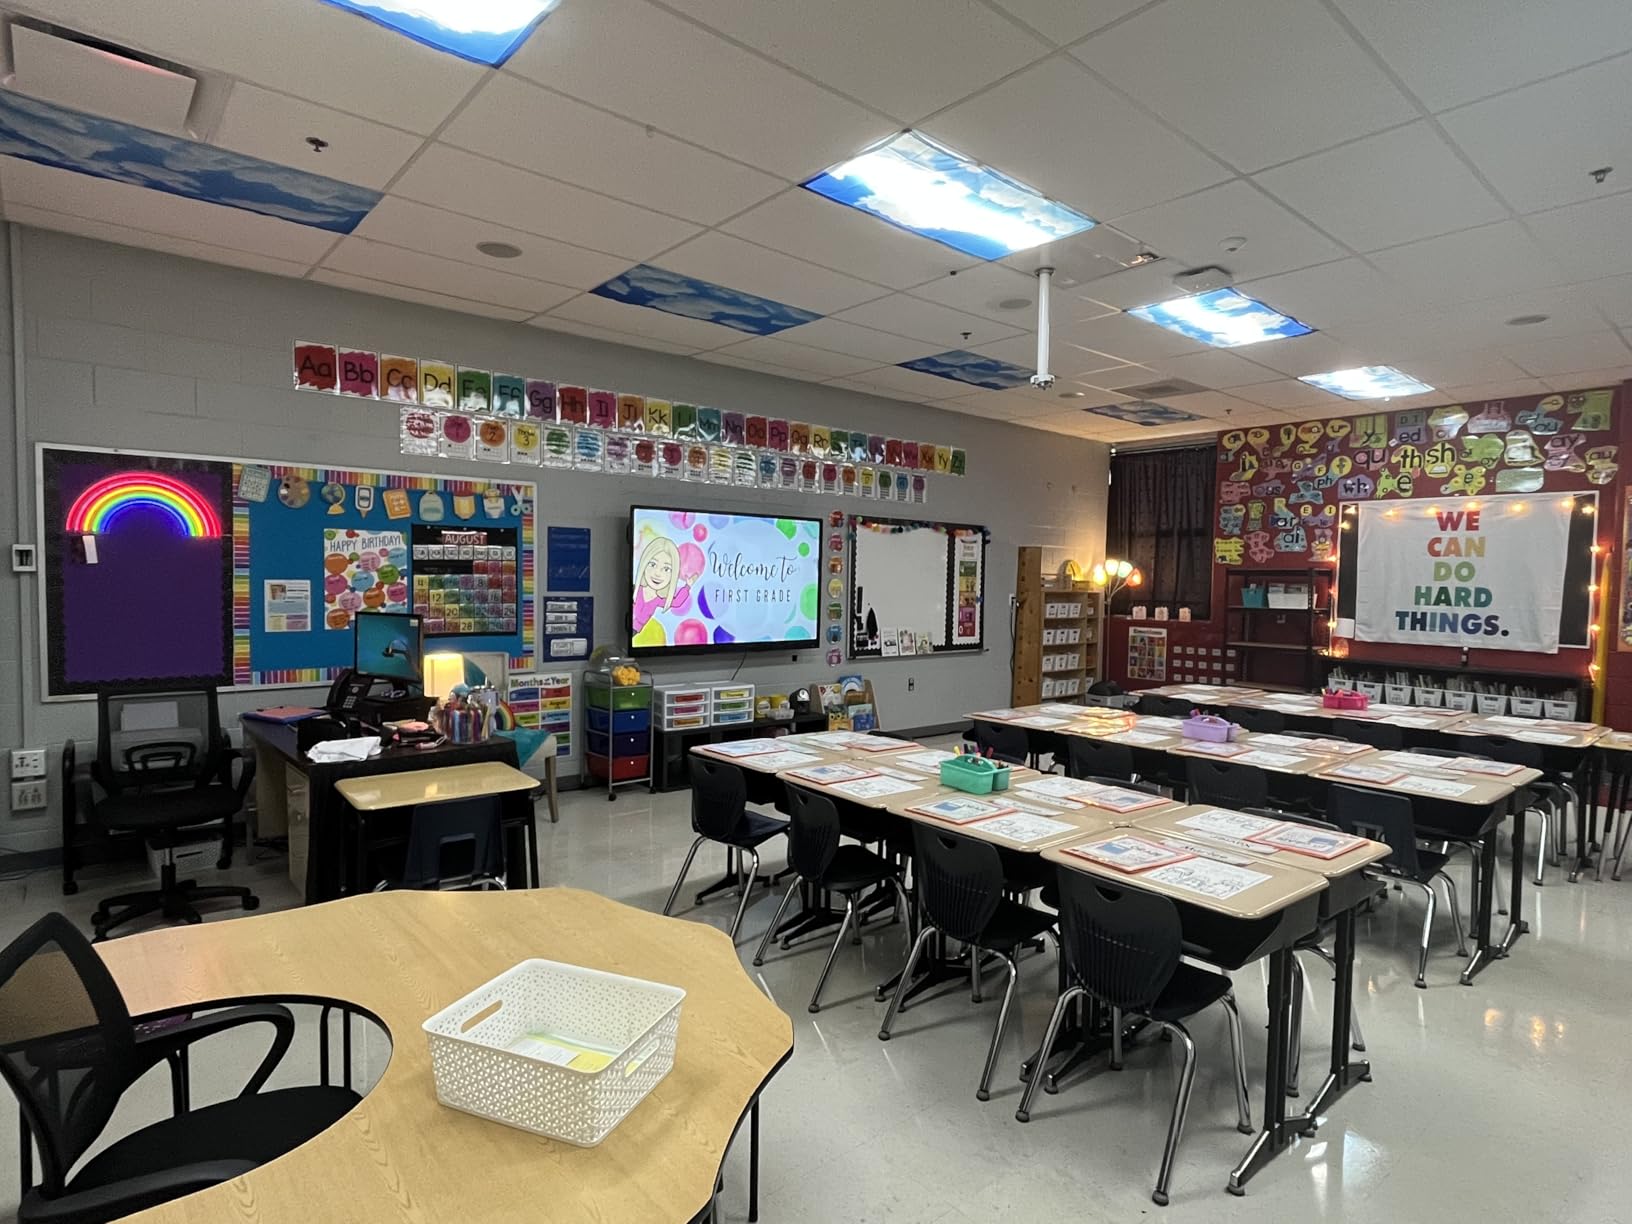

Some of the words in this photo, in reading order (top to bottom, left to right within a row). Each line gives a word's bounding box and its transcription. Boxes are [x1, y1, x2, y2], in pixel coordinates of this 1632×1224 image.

[300, 355, 334, 377] Aa
[344, 361, 375, 384] Bb
[424, 373, 453, 393] Dd
[529, 390, 553, 414] Gg
[489, 431, 498, 443] 2
[523, 435, 530, 447] 3
[1399, 428, 1421, 442] ed
[1354, 447, 1386, 470] qu
[1401, 448, 1422, 468] th
[1426, 441, 1455, 464] sh
[1316, 476, 1334, 488] ph
[1397, 475, 1412, 492] e
[1436, 510, 1481, 531] WE
[330, 540, 358, 552] HAPPY
[445, 534, 485, 544] AUGUST
[1427, 536, 1486, 557] CAN
[708, 541, 779, 581] Welcome
[776, 555, 800, 583] to
[1433, 561, 1476, 582] DO
[417, 577, 424, 586] 4
[432, 593, 442, 602] 12
[715, 588, 749, 603] FIRST
[756, 588, 791, 603] GRADE
[1414, 586, 1493, 607] HARD
[447, 607, 458, 617] 20
[461, 622, 472, 631] 28
[1395, 611, 1510, 636] THINGS.
[511, 678, 543, 688] Months
[551, 677, 569, 685] Year
